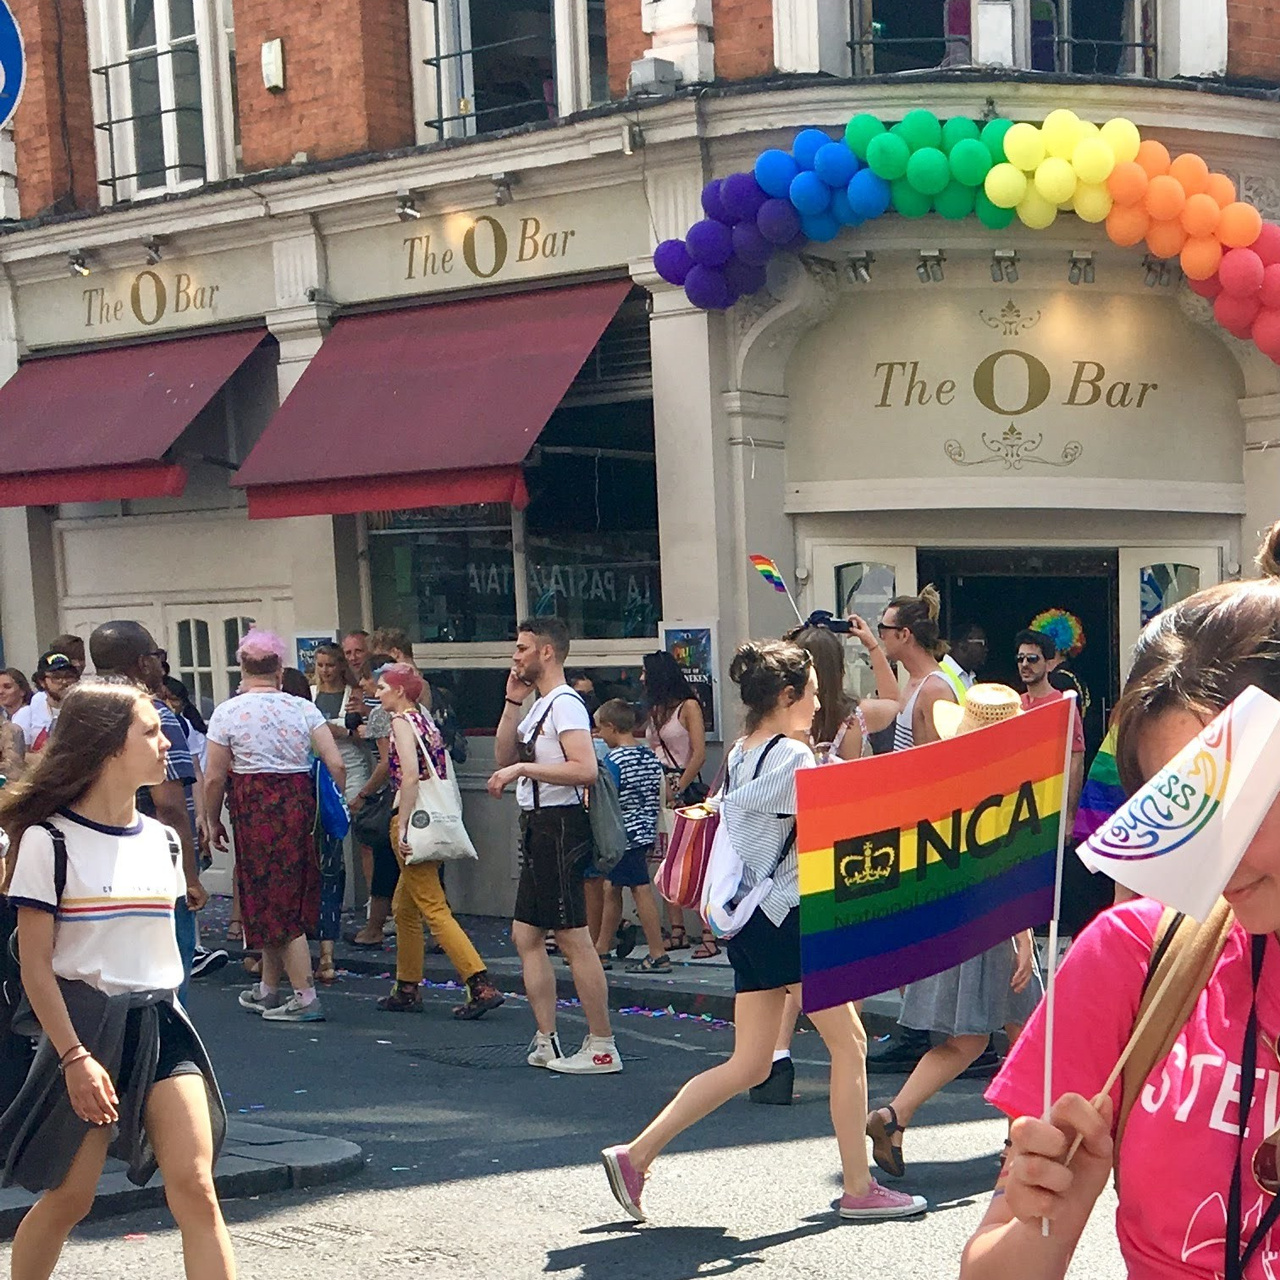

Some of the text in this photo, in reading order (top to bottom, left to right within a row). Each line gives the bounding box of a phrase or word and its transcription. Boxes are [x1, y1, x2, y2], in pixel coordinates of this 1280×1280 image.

[403, 215, 576, 280] The O Bar
[82, 270, 220, 327] The O Bar
[874, 349, 1158, 416] The O Bar
[916, 780, 1042, 882] NCA
